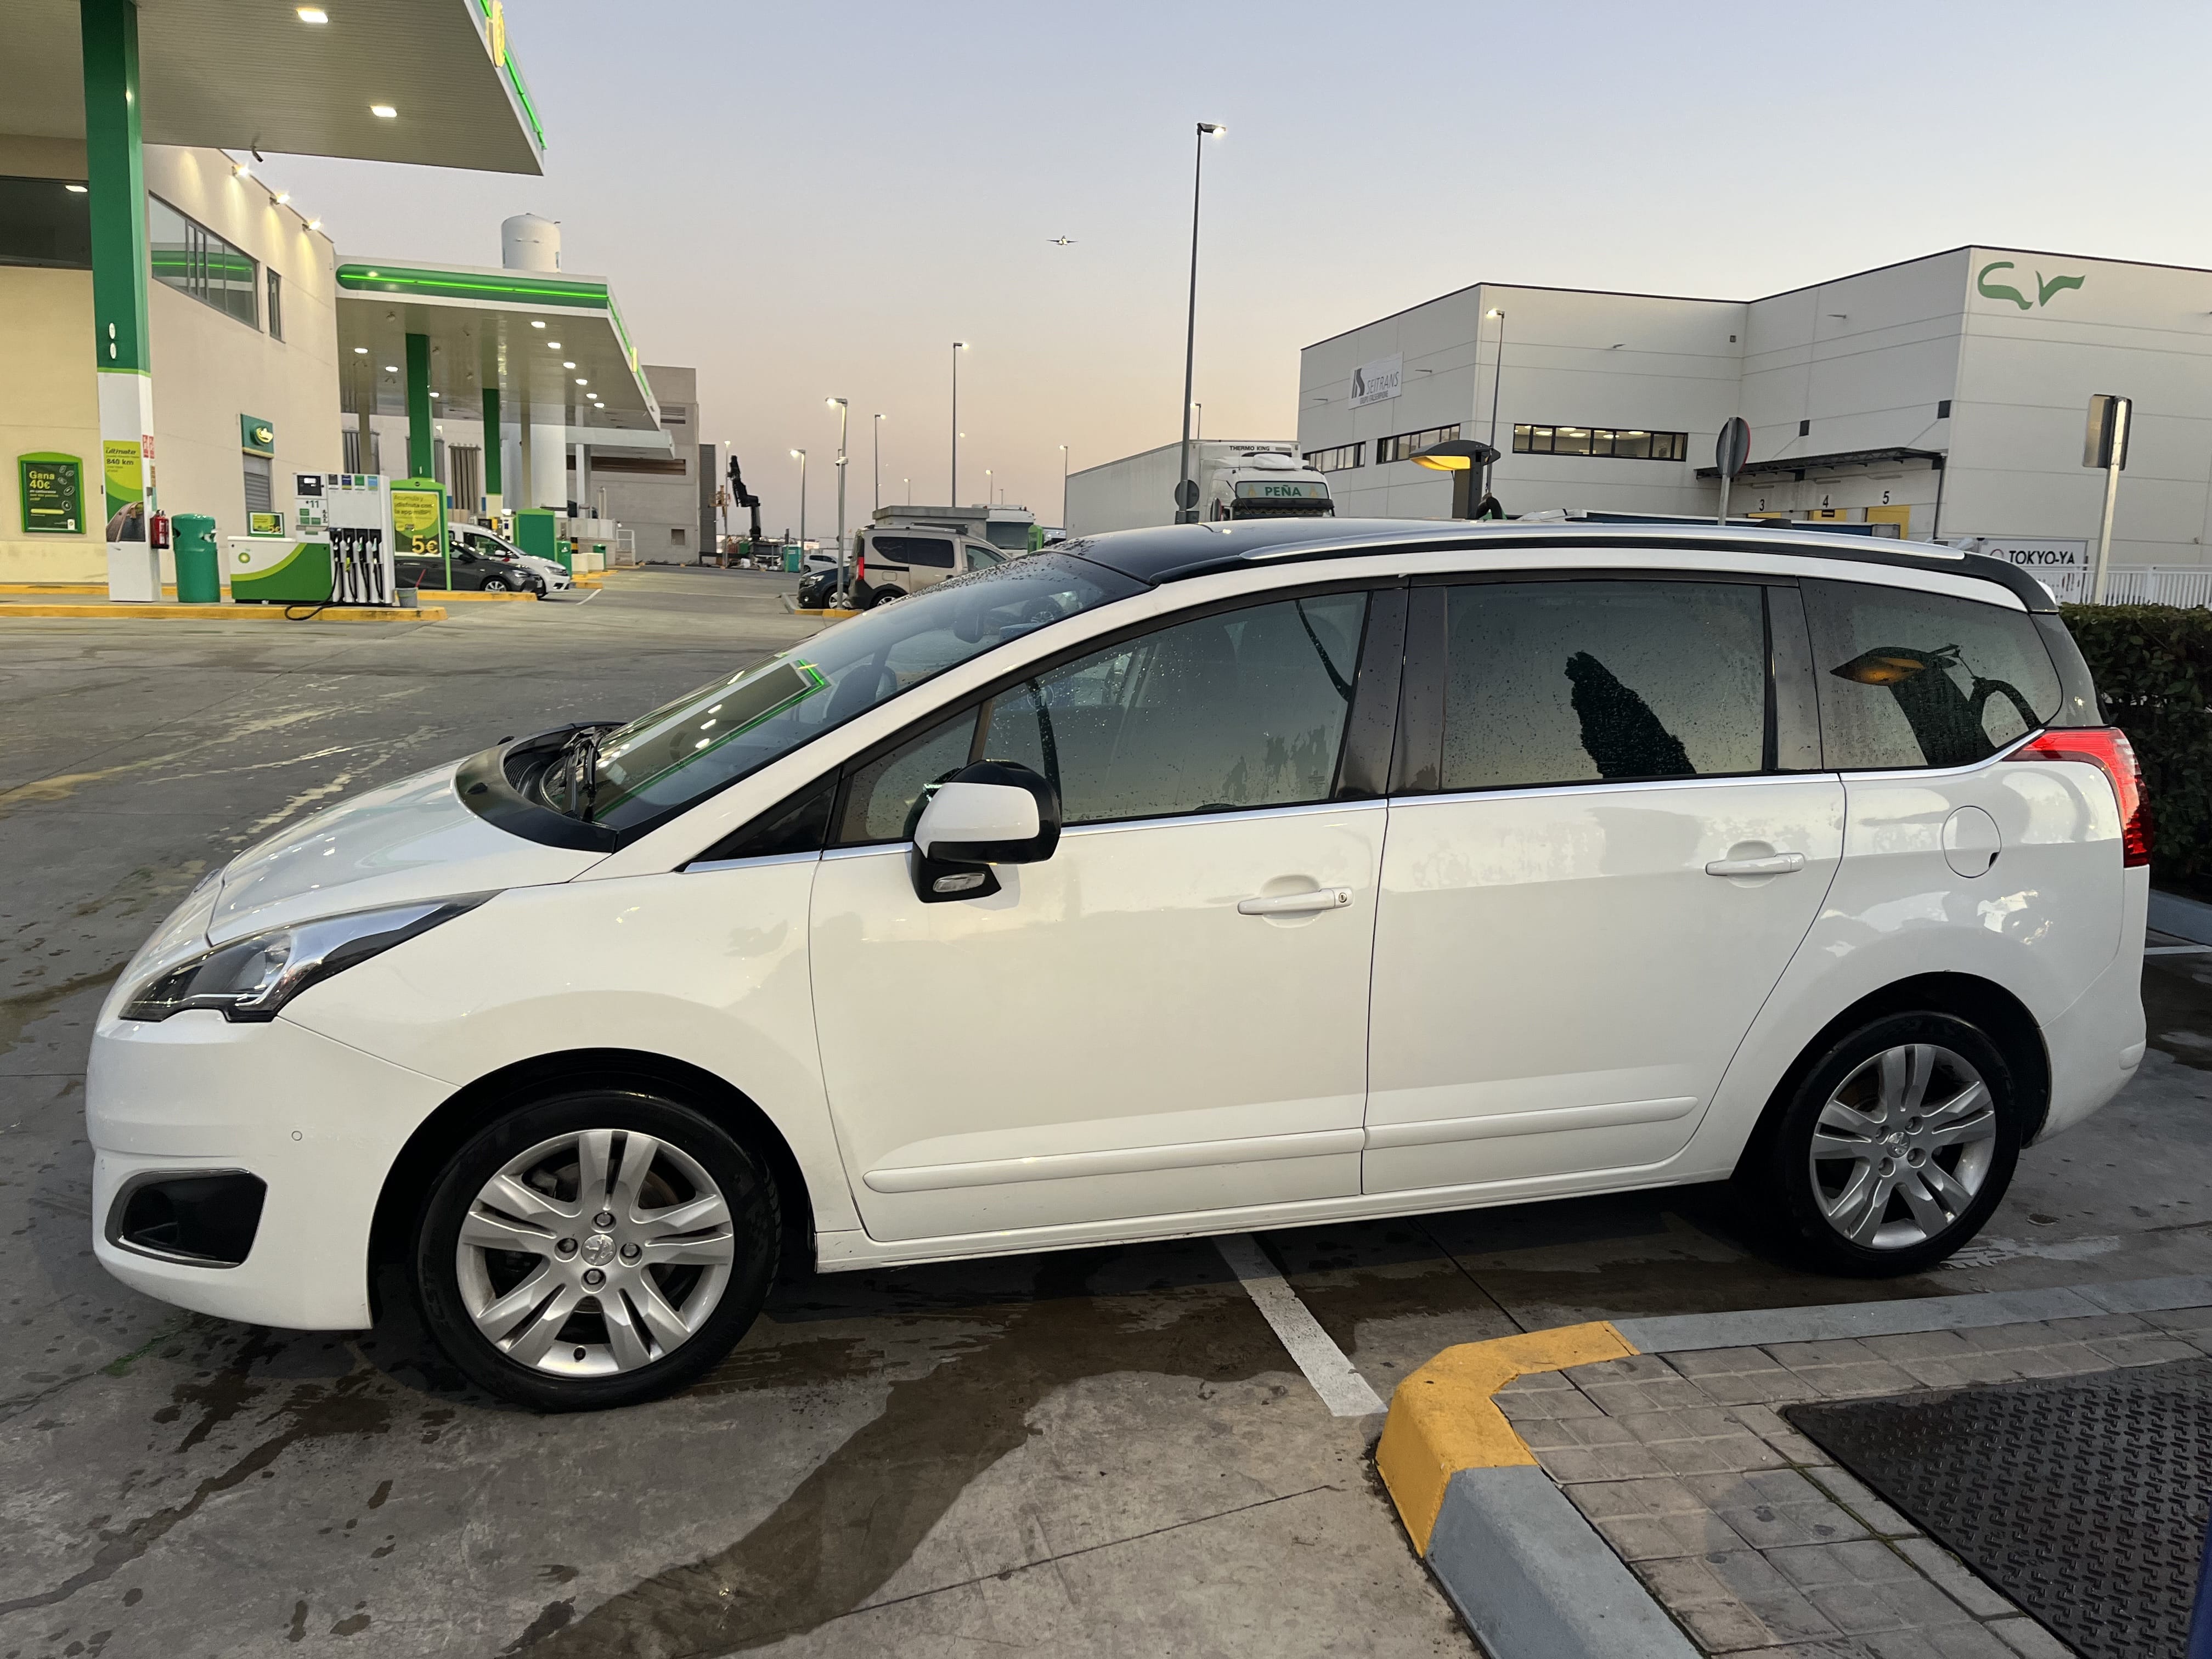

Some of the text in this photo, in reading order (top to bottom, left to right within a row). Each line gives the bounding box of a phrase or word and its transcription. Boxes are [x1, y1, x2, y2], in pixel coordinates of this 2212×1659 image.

[1366, 371, 1400, 395] SEITRANS
[29, 470, 55, 480] Gana
[30, 479, 50, 489] 40€
[1265, 484, 1302, 496] PEÑA
[1822, 495, 1829, 508] 4
[1882, 490, 1890, 504] 5
[310, 500, 319, 509] 11
[1759, 499, 1765, 511] 3
[411, 535, 438, 555] 5€
[2009, 550, 2075, 565] TOKYO-YA
